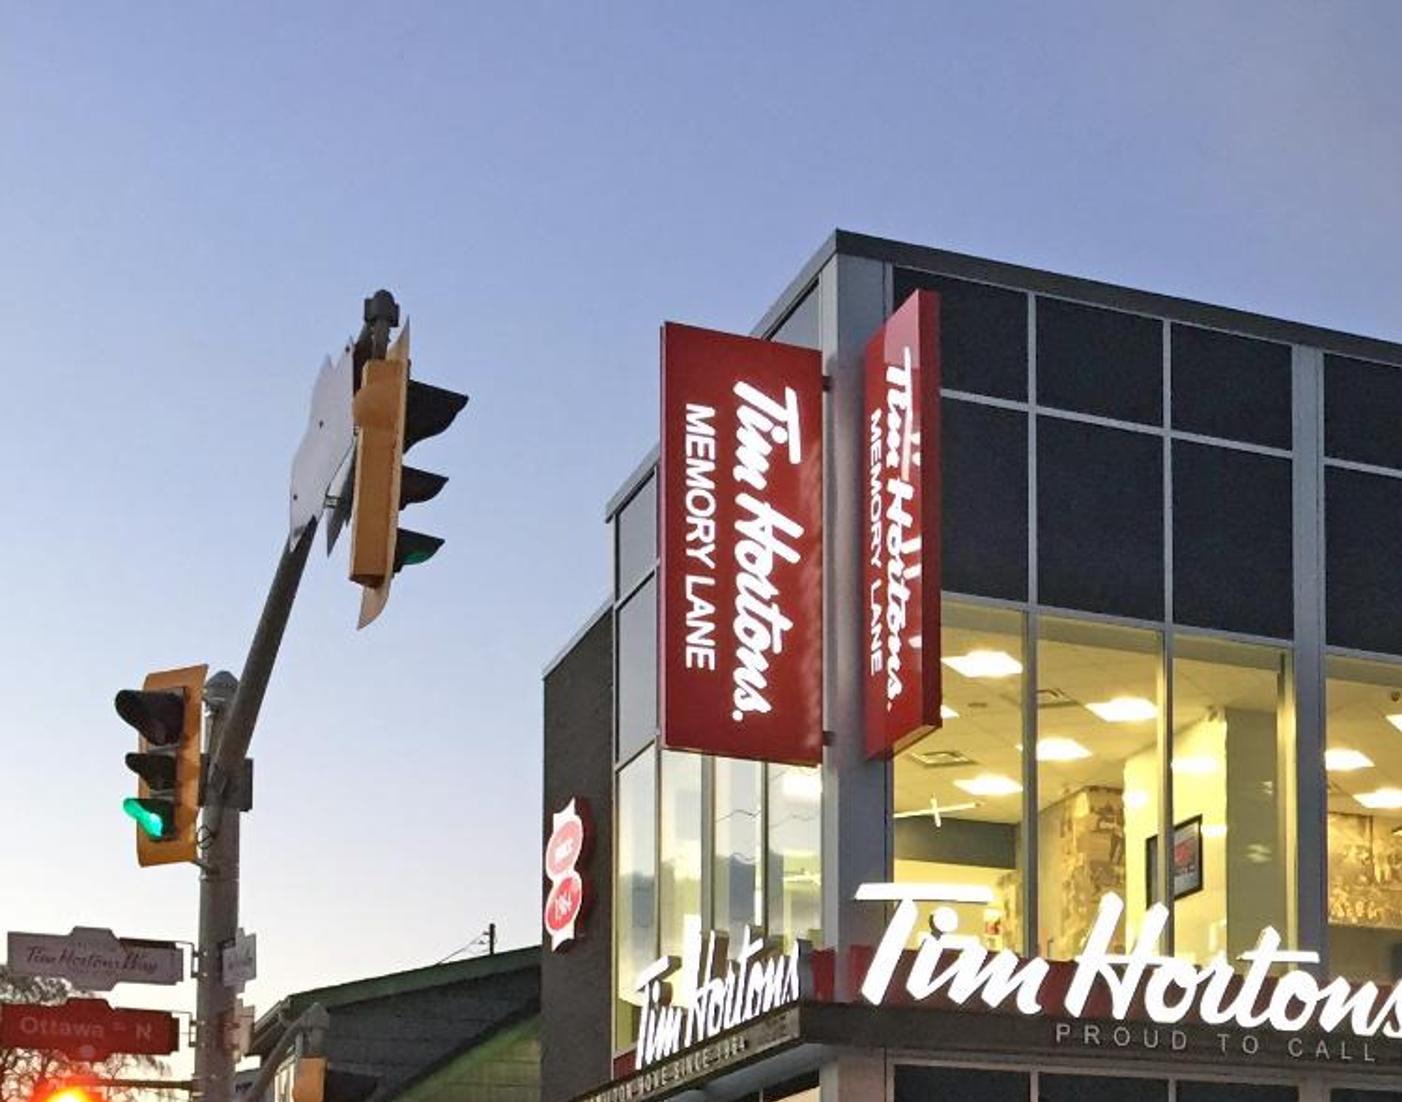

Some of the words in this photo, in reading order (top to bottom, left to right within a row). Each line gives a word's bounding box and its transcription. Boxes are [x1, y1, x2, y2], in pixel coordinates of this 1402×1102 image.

[685, 403, 716, 570] MEMORY
[733, 379, 802, 491] Tim
[870, 408, 883, 566] MEMORY
[685, 576, 716, 671] LANE
[869, 580, 884, 676] LANE
[634, 954, 682, 1070] Tim
[683, 922, 800, 1047] Hortons
[855, 881, 1050, 1015] Tim
[20, 1016, 104, 1039] Ottawa
[135, 1024, 153, 1041] N
[673, 1047, 710, 1080] SINCE
[1055, 1022, 1188, 1051] PROUD
[1217, 1032, 1258, 1056] TO
[1288, 1037, 1376, 1063] CALL
